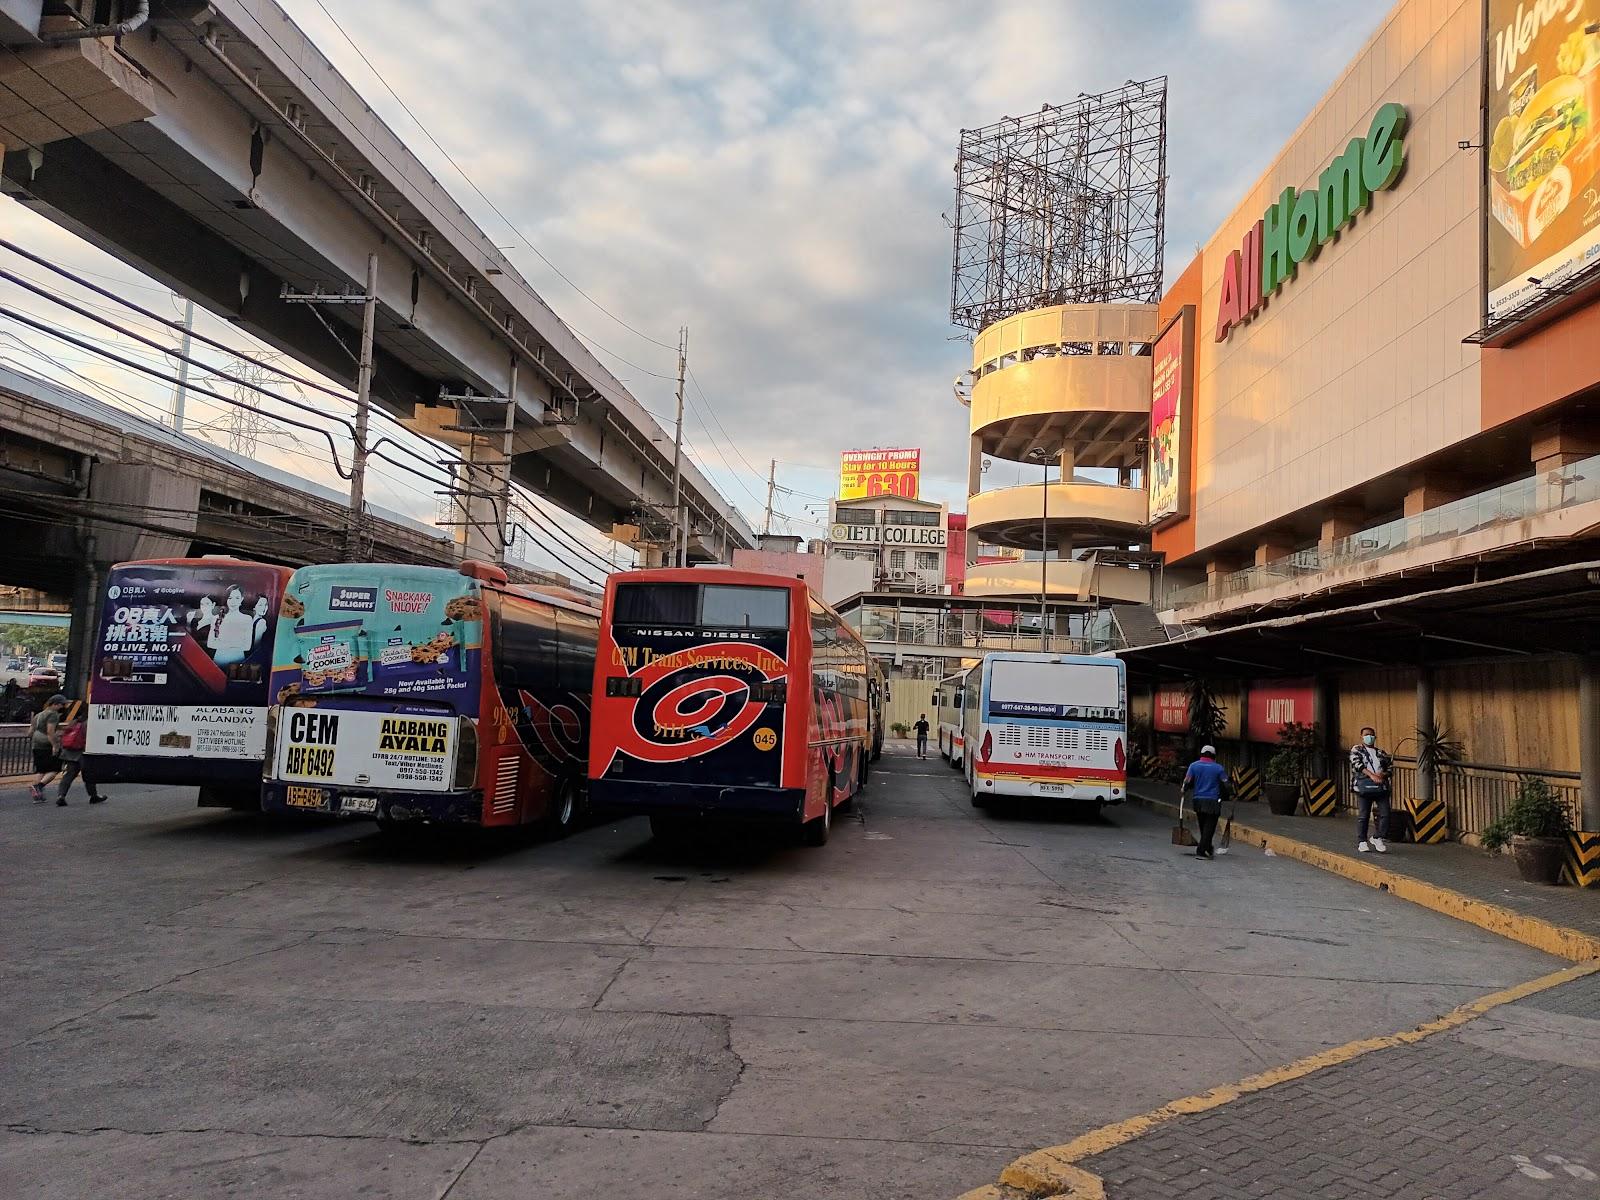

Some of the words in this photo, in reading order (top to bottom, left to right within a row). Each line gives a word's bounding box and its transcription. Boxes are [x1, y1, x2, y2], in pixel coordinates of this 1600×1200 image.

[1215, 103, 1406, 343] AllHome
[843, 452, 888, 462] OVERNIGHT
[888, 450, 918, 460] PROMO
[843, 462, 862, 472] Stay
[863, 462, 876, 471] for
[879, 462, 888, 470] 10
[889, 461, 917, 470] Hours
[847, 525, 881, 541] IETI
[884, 527, 946, 545] COLLEGE
[340, 589, 371, 600] SUPER
[385, 589, 432, 602] SNACKAKA
[332, 598, 375, 609] DELIGHTS
[637, 629, 694, 637] NISSAN
[702, 631, 761, 639] DIESEL
[104, 644, 119, 652] OB
[121, 644, 149, 653] LIVE,
[313, 657, 346, 668] COOKIES
[611, 646, 639, 667] CEM
[642, 647, 683, 668] Trans
[687, 650, 753, 674] Services,
[756, 652, 784, 672] Inc.
[384, 687, 397, 695] 28g
[412, 685, 425, 693] 40g
[426, 683, 446, 691] Snack
[447, 681, 467, 689] Packs!
[415, 677, 446, 686] Available
[97, 704, 111, 720] CEM
[112, 705, 132, 721] TRANS
[195, 707, 254, 715] ALABANG
[1266, 699, 1295, 724] LAWTON
[191, 715, 256, 724] MALANDAY
[290, 712, 339, 745] CEM
[381, 719, 447, 738] ALABANG
[653, 722, 685, 738] 9114
[116, 729, 151, 746] TYP-308
[379, 735, 446, 753] AYALA
[754, 734, 776, 745] 045
[286, 747, 307, 775] ABF
[307, 748, 335, 777] 6492
